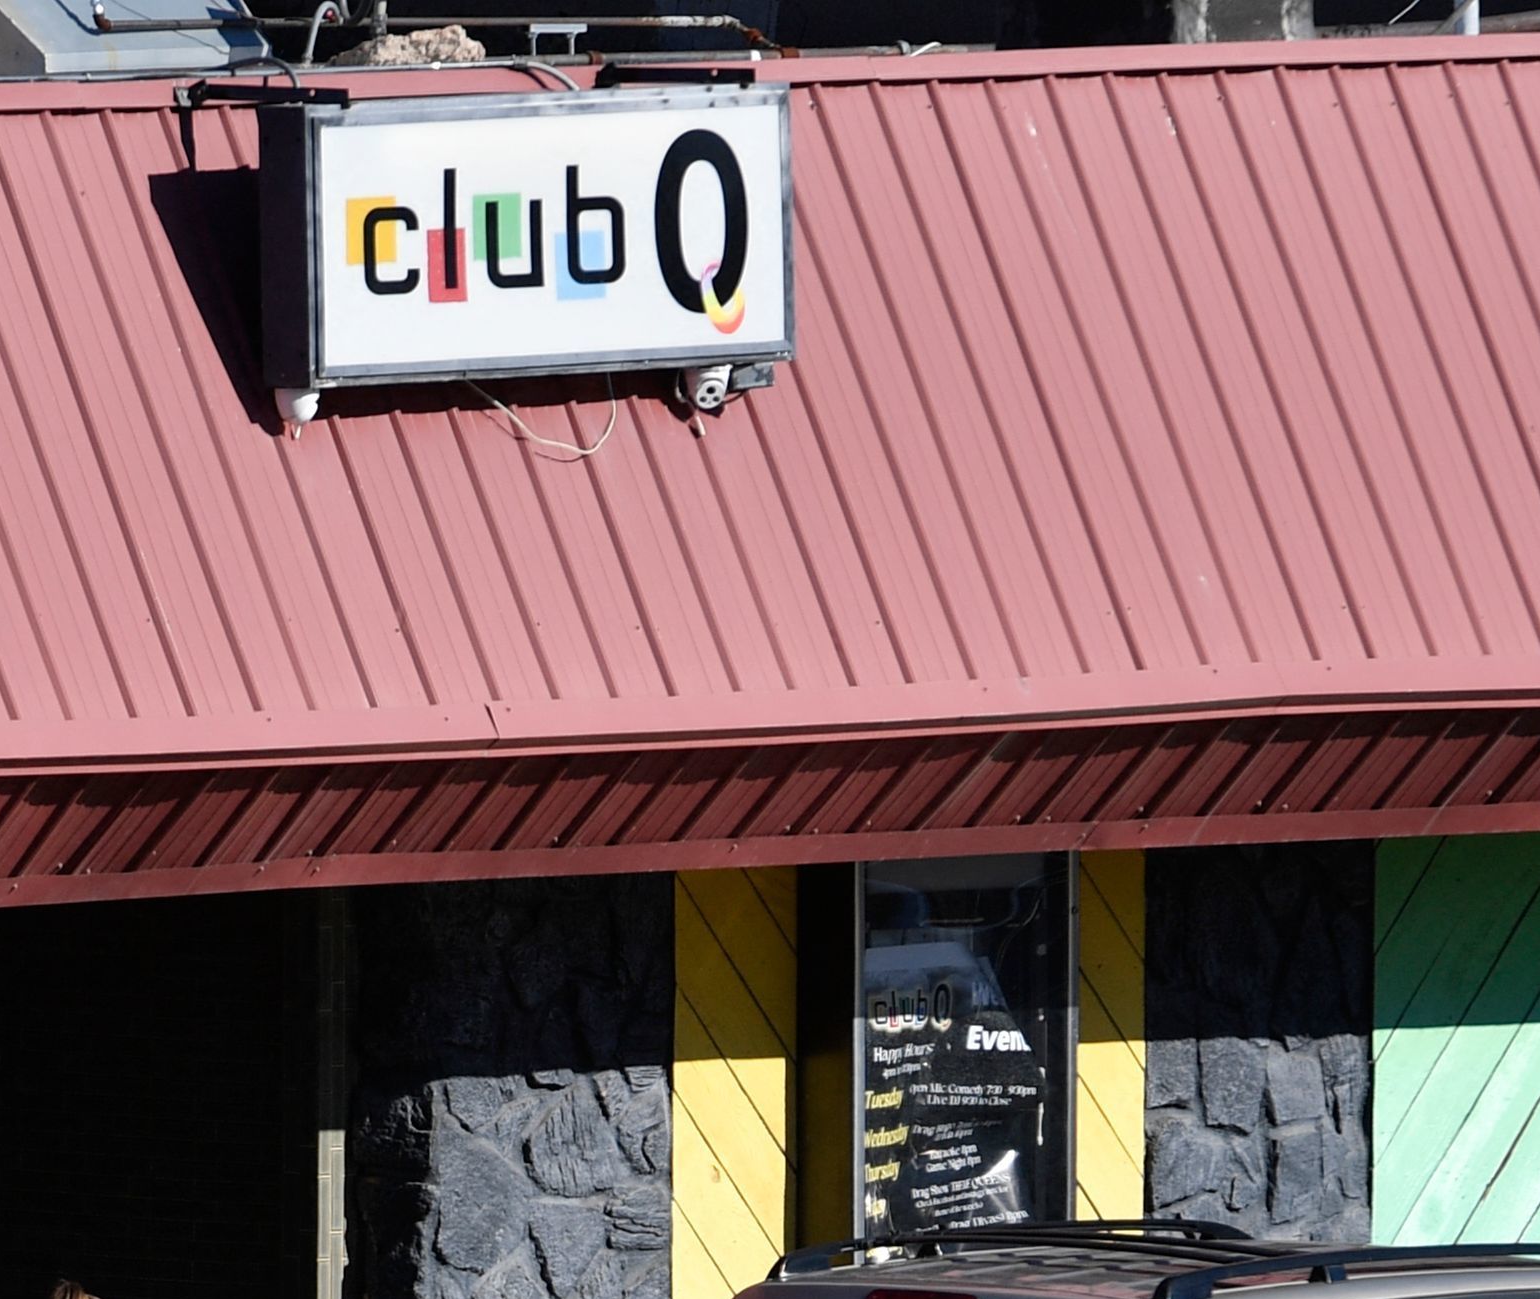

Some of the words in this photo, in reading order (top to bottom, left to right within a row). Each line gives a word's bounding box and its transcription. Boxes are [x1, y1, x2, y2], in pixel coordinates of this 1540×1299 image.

[363, 165, 627, 295] club
[655, 129, 748, 334] Q
[873, 989, 928, 1026] club
[934, 984, 951, 1027] Q
[864, 1086, 904, 1109] Tuesday
[864, 1123, 909, 1148] Wednesday
